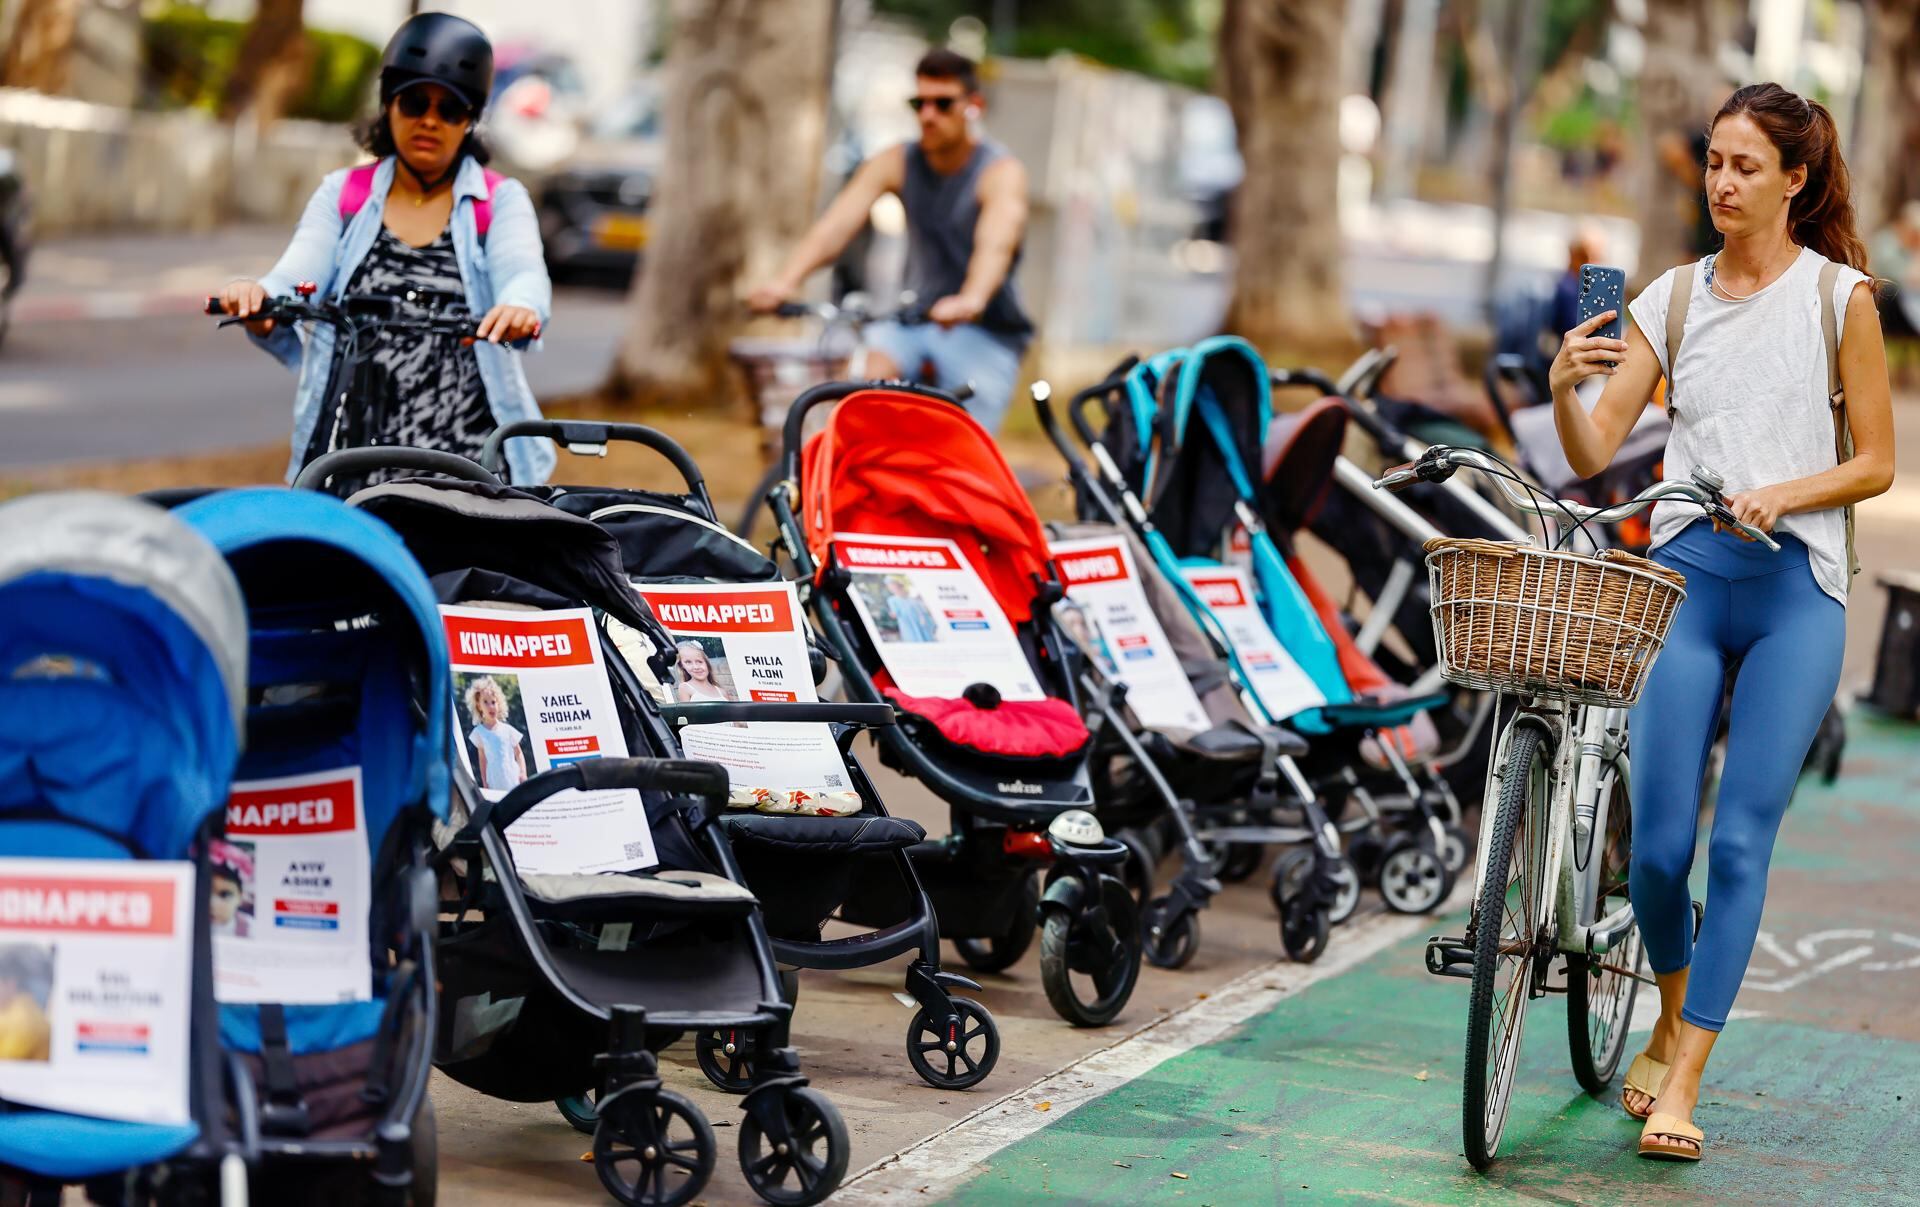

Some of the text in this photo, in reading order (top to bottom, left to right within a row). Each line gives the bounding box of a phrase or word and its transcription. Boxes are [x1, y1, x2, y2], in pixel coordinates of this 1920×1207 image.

[659, 603, 774, 623] KIDNAPPED
[459, 631, 572, 657] KIDNAPPED
[744, 655, 783, 666] EMILIA
[752, 668, 784, 679] ALONI
[541, 694, 582, 708] YAHEL
[540, 709, 592, 724] SHOHAM
